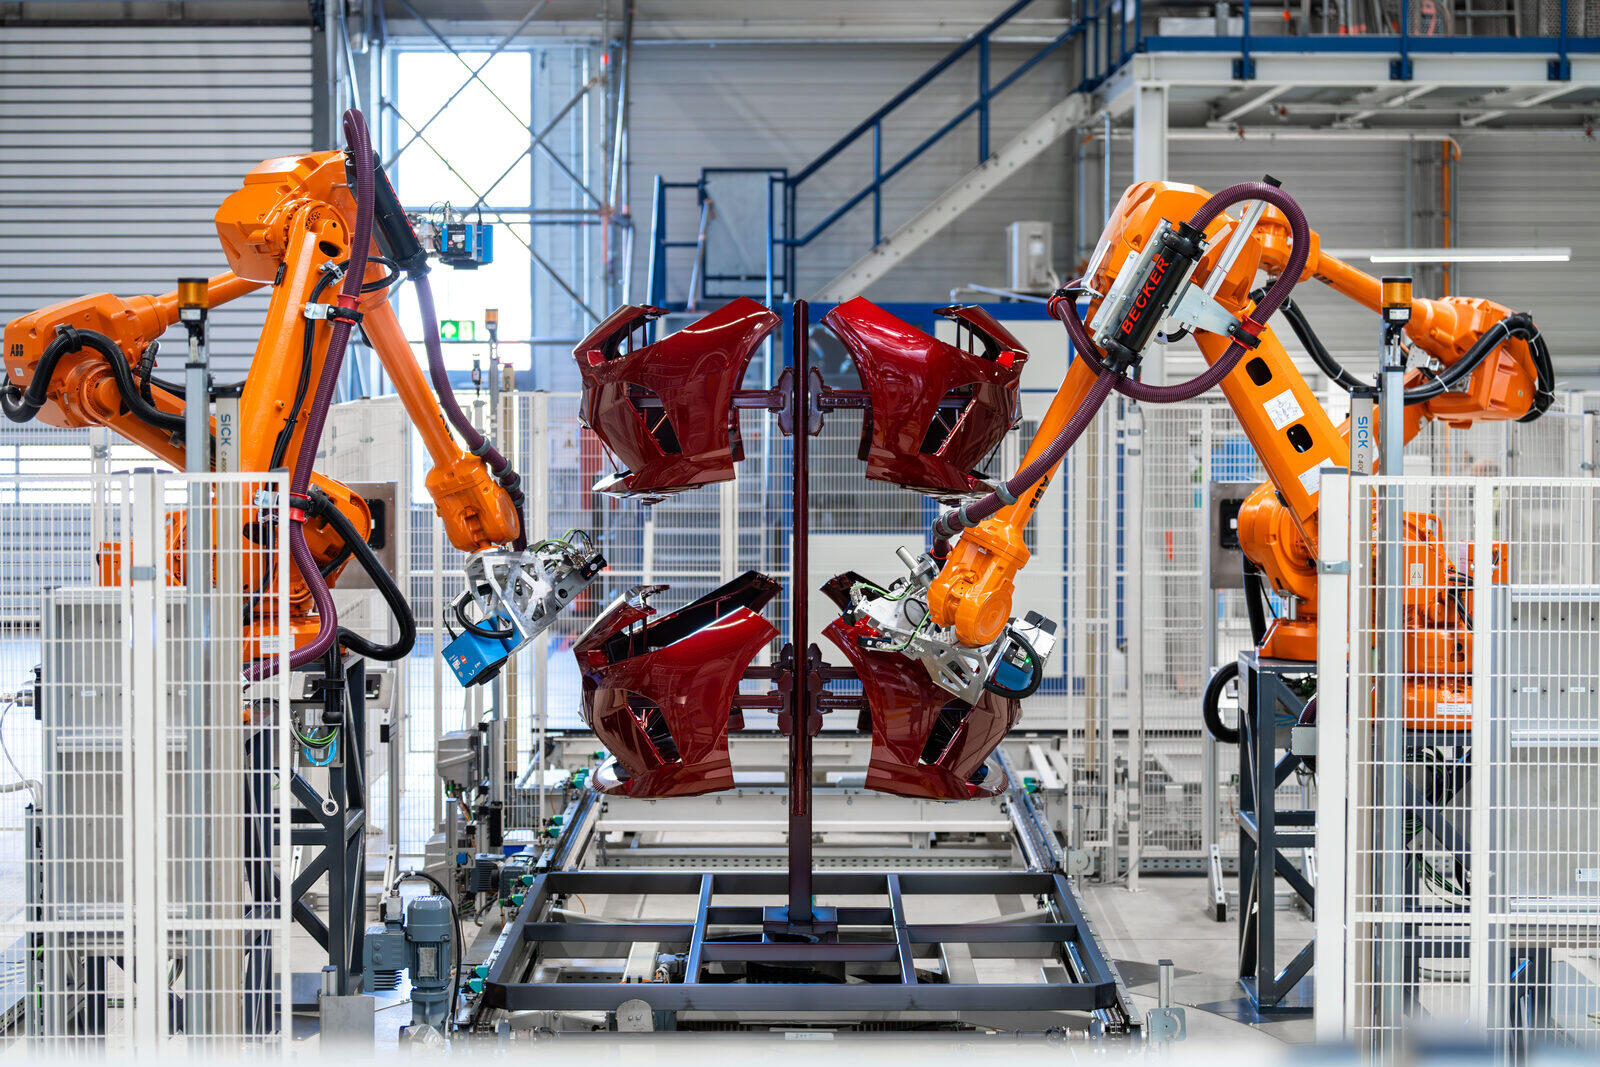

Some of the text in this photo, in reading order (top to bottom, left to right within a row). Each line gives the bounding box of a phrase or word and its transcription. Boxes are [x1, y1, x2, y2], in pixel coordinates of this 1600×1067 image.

[1121, 257, 1169, 335] BECKER
[10, 343, 24, 357] ABB
[221, 414, 231, 446] SICK
[1357, 416, 1368, 448] SICK
